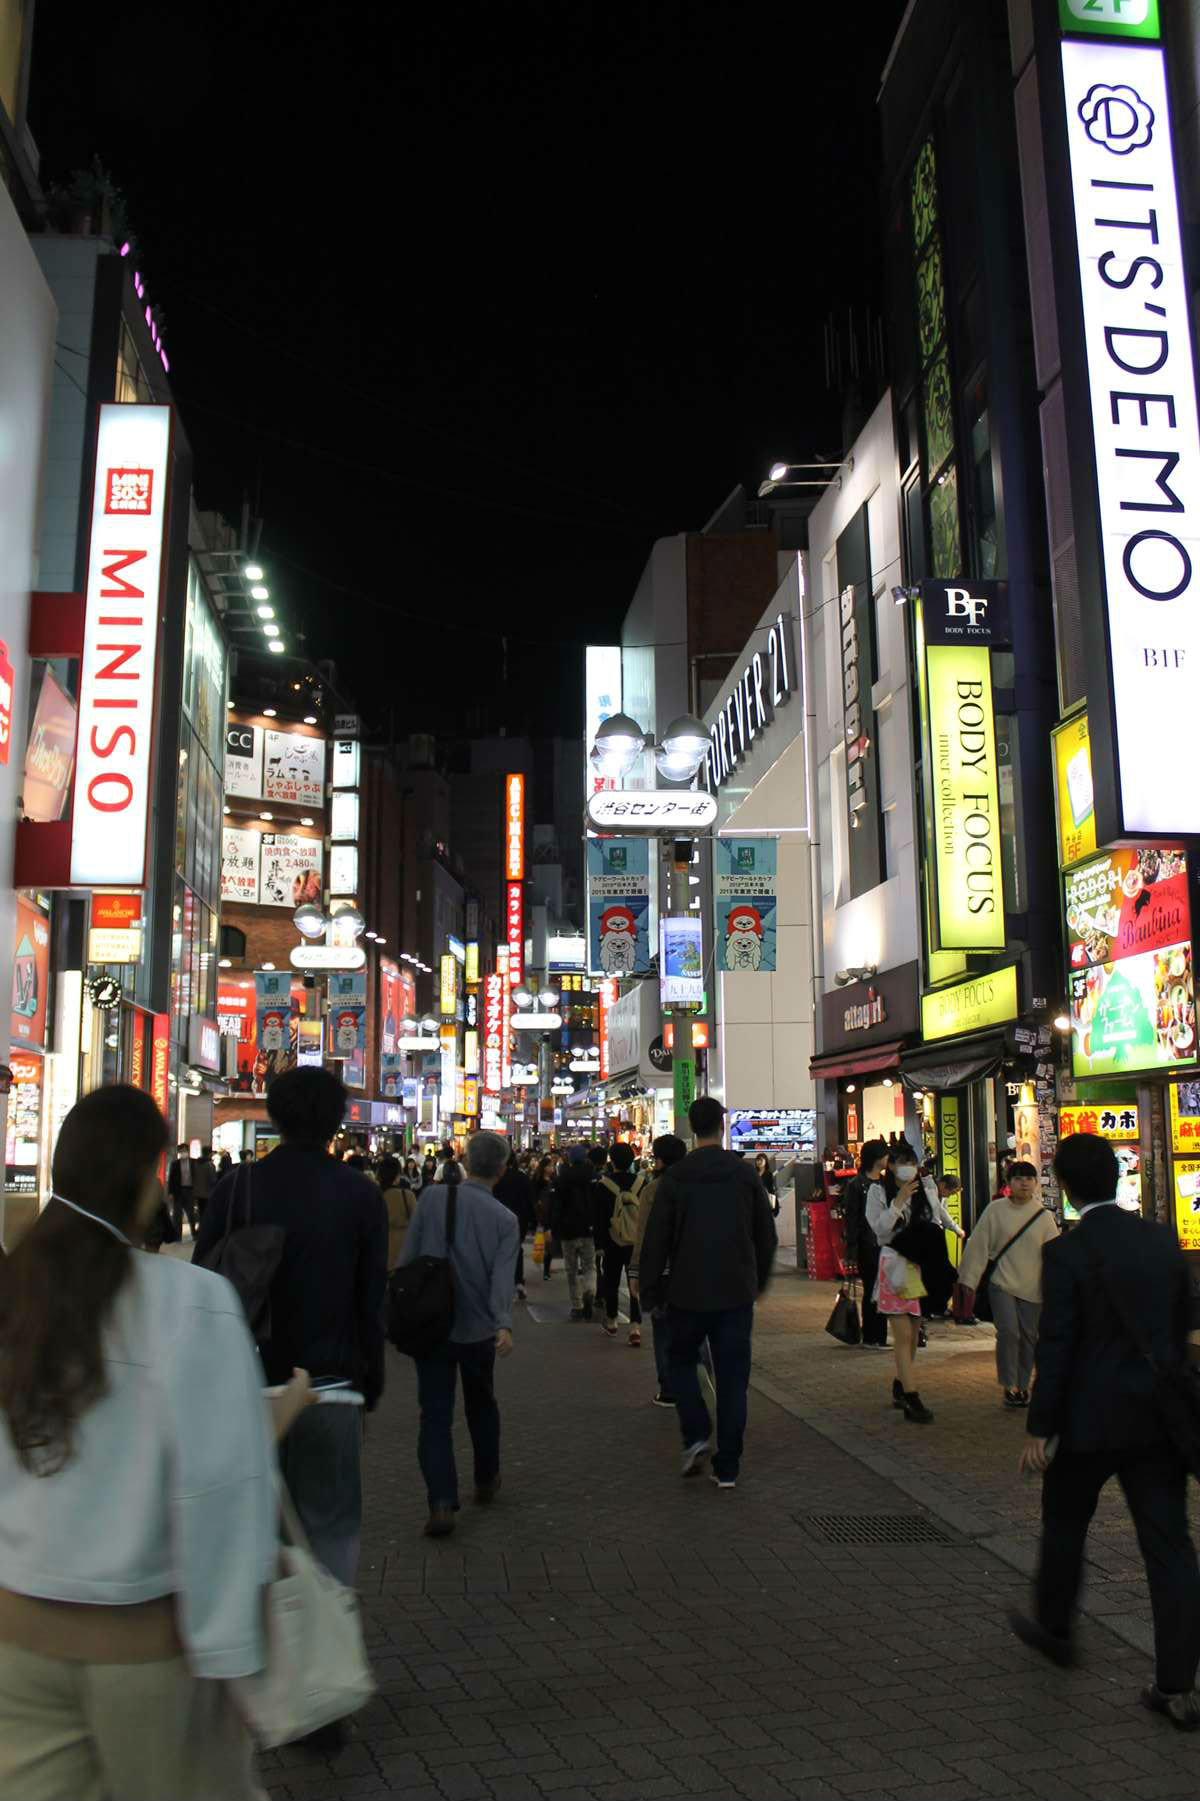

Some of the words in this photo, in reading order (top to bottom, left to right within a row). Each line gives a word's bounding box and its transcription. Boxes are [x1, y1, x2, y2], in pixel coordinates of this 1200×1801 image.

[944, 627, 964, 635] BODY
[967, 627, 992, 635] FOCUS
[87, 550, 147, 812] MINISO
[705, 652, 767, 793] FOREVER
[768, 613, 790, 706] 21
[957, 681, 988, 776] BODY
[939, 734, 950, 775] inner
[267, 779, 321, 793] しゃぶしゃぶ
[596, 801, 710, 816] 渋谷センター街
[941, 778, 956, 855] collection
[963, 793, 995, 914] FOCUS
[940, 991, 960, 1016] BODY
[964, 979, 994, 1008] FOCUS
[943, 1112, 957, 1160] BODY
